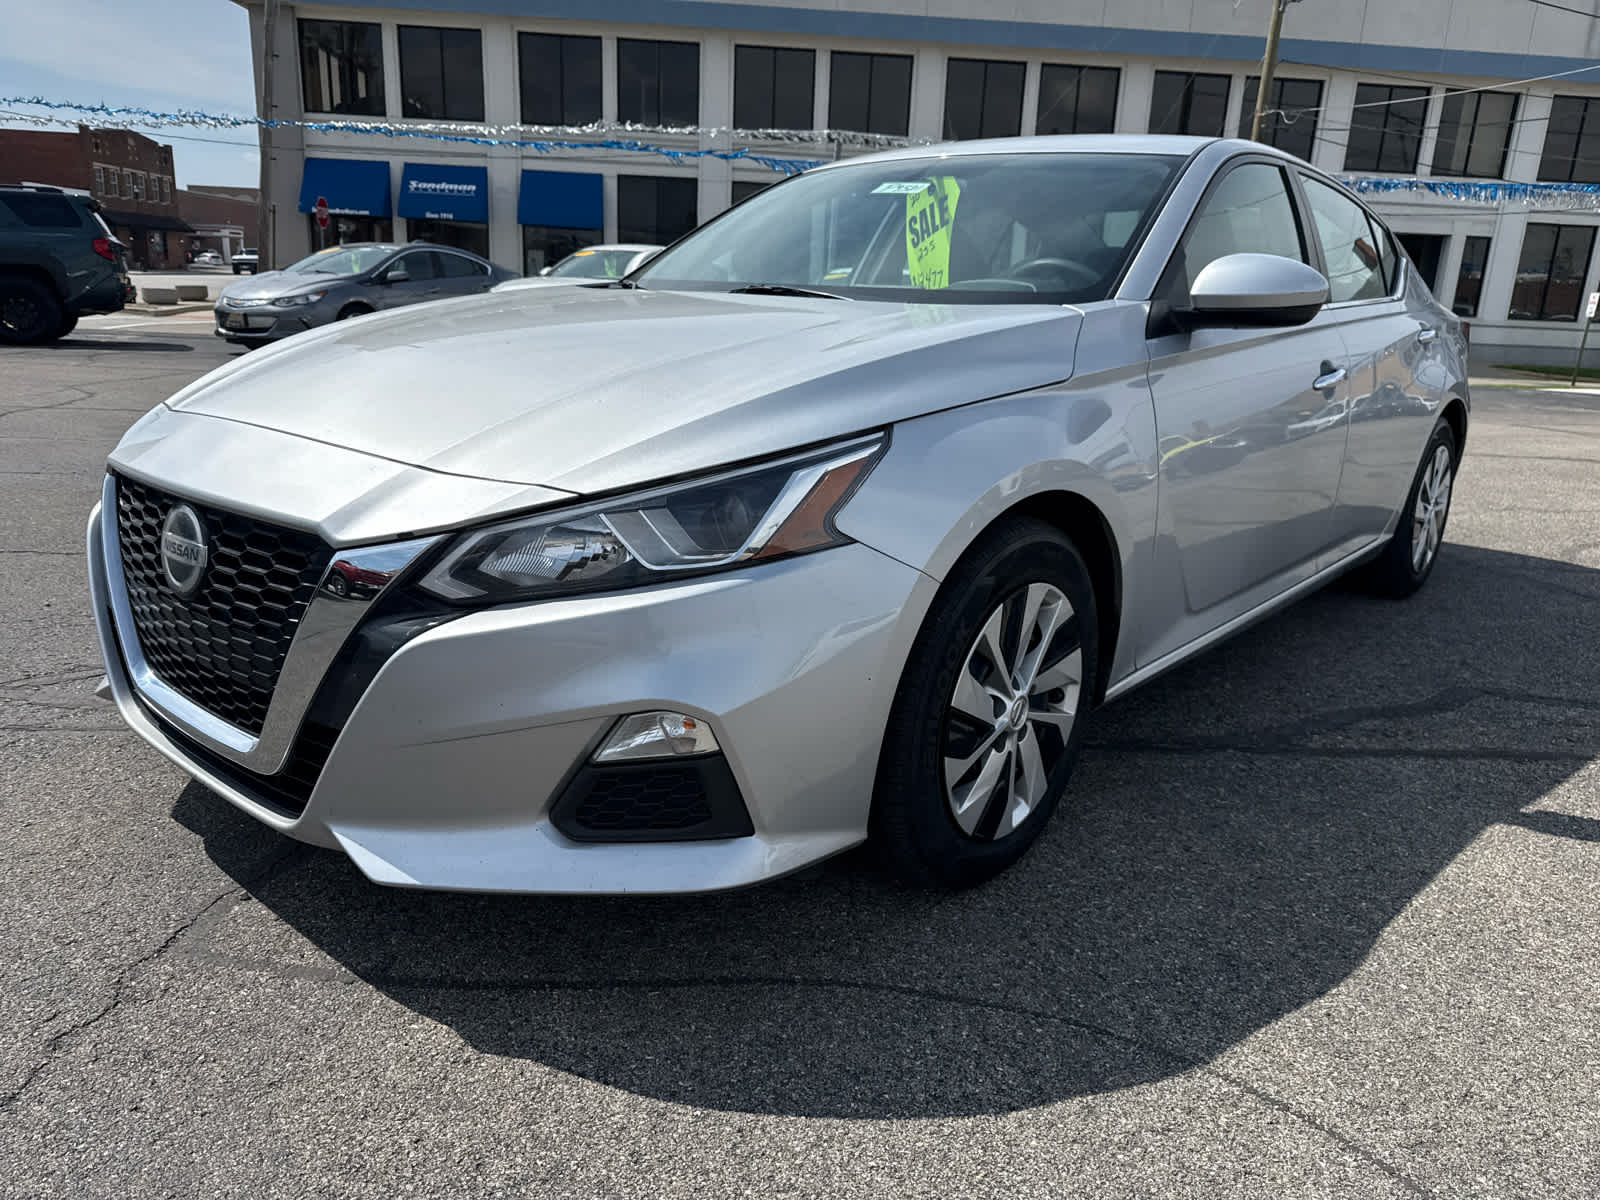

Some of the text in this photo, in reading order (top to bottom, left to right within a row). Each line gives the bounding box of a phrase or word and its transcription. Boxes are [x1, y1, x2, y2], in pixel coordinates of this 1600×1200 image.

[409, 180, 477, 194] Sandman
[909, 194, 949, 248] SALE
[164, 538, 199, 561] NISSAN
